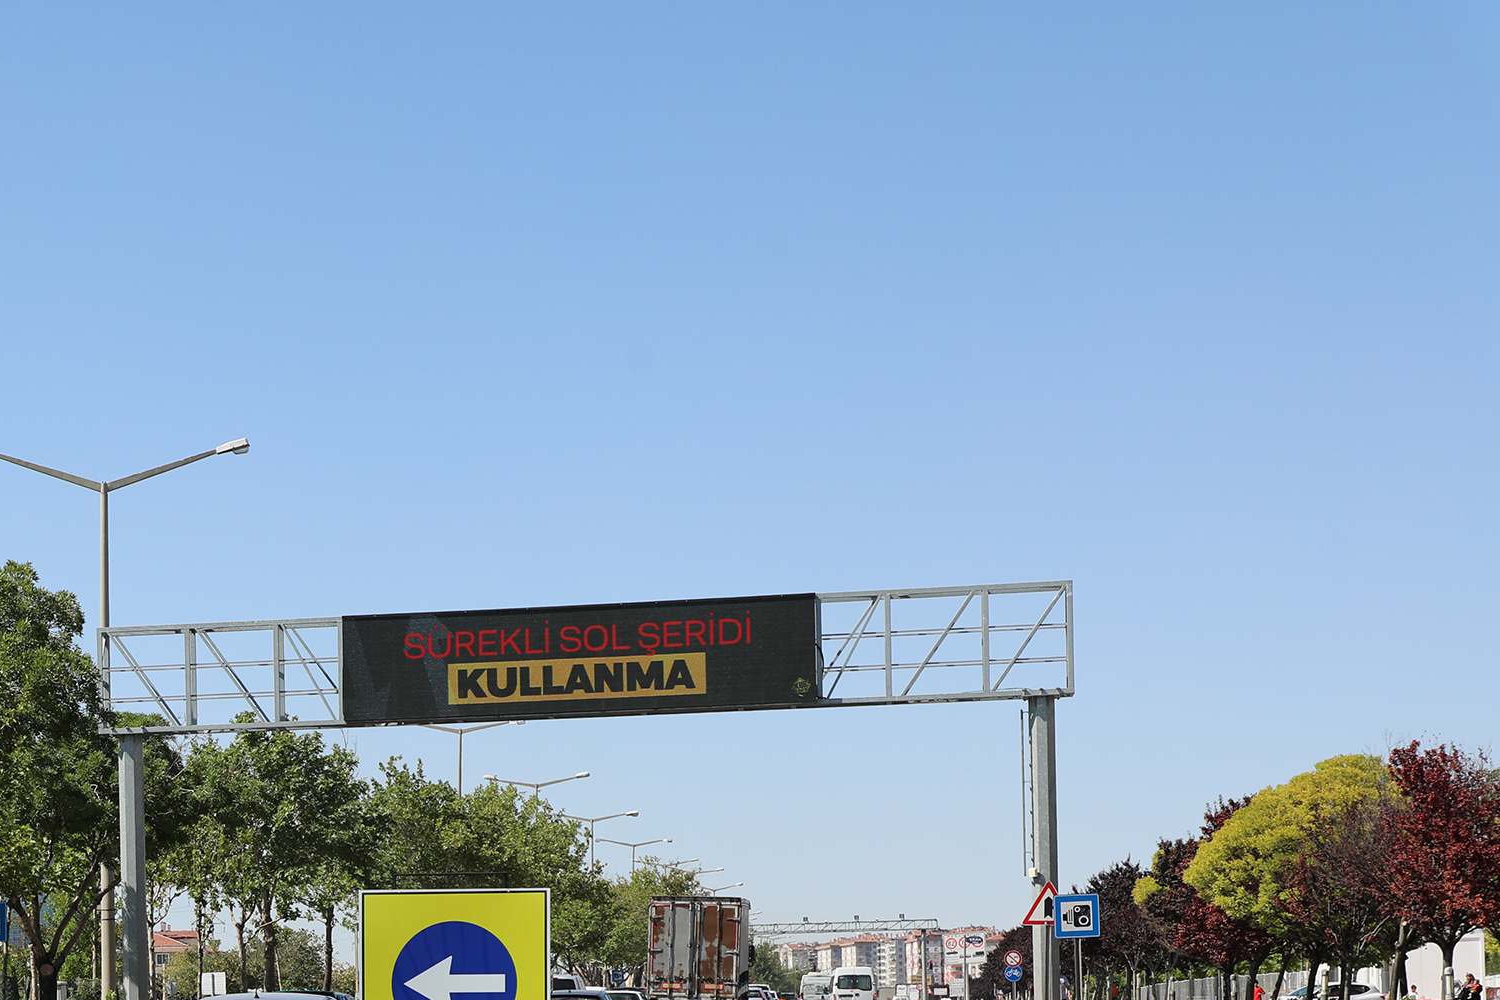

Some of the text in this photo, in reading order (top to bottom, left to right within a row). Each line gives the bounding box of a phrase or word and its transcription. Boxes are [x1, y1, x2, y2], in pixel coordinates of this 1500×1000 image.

[403, 610, 752, 660] SÜREKLİ SOL ŞERİDİ
[457, 659, 695, 699] KULLANMA
